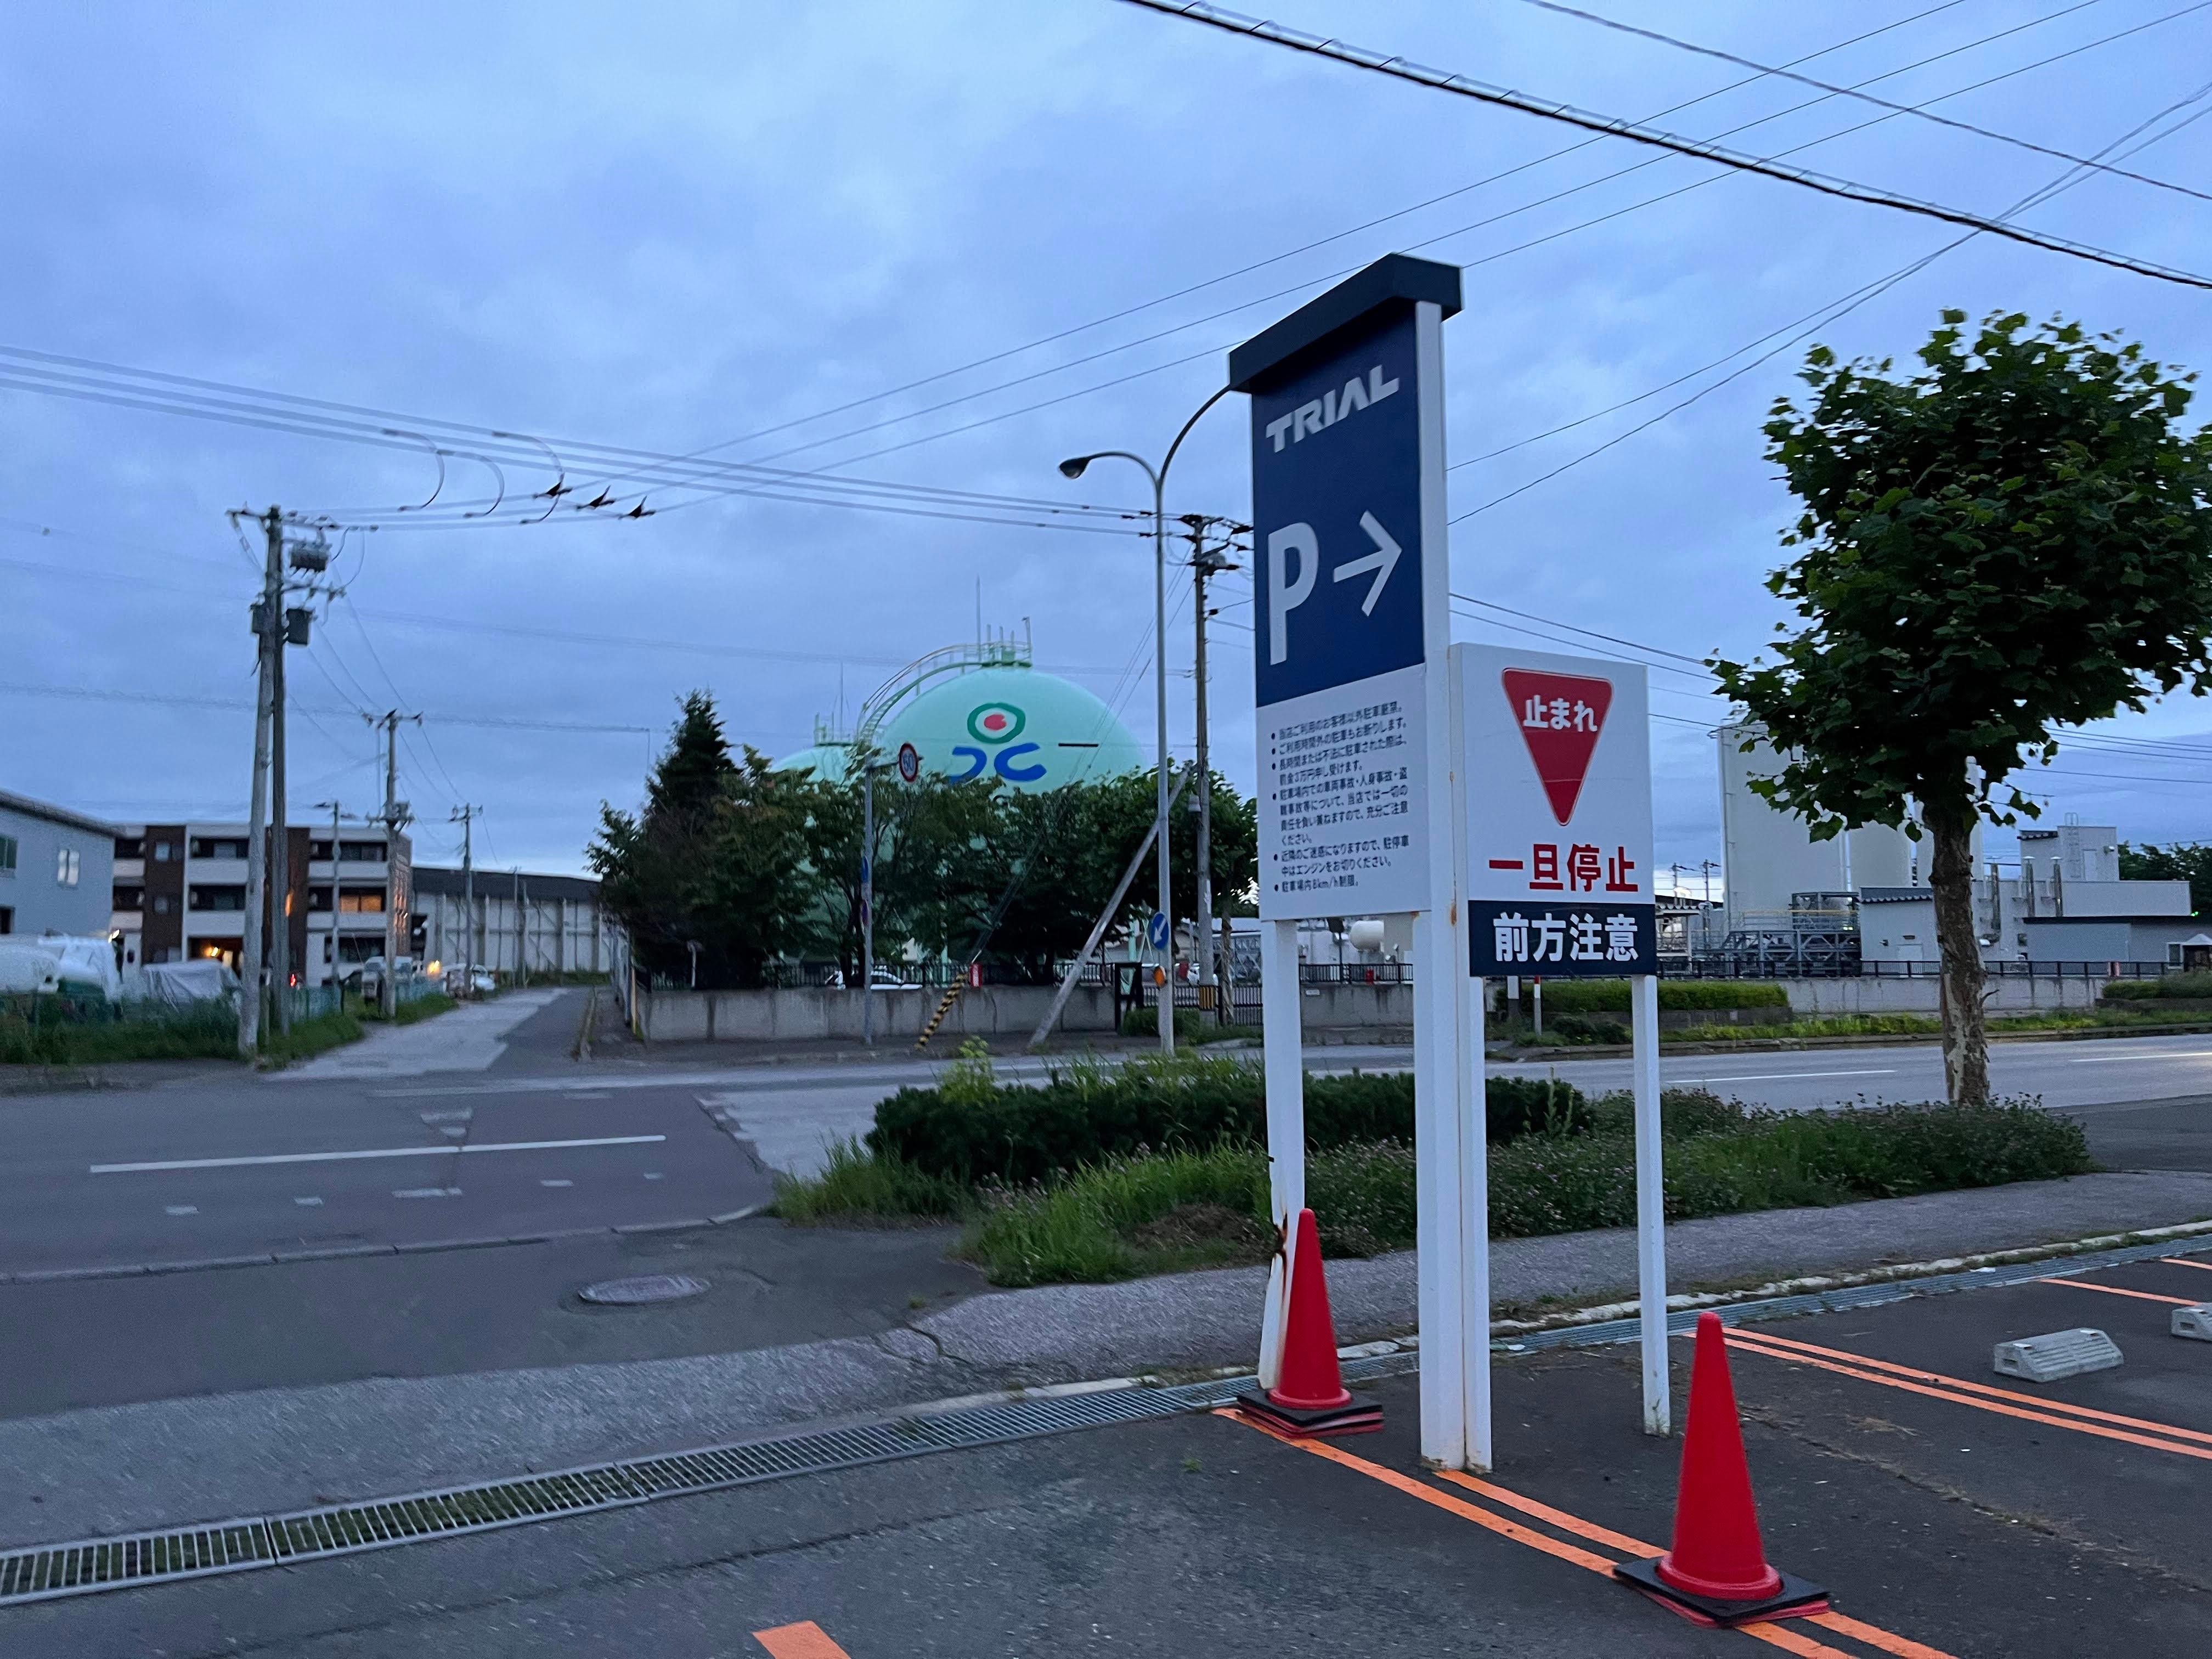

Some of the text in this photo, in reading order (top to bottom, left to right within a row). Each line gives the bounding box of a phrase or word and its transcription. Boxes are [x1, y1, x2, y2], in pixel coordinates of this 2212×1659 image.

[1266, 364, 1400, 453] TRIAL
[1268, 522, 1318, 665] P
[1523, 695, 1598, 732] 止まれ
[1281, 833, 1312, 846] ください。
[1489, 843, 1638, 892] 一旦停止
[1493, 912, 1638, 962] 前方注意
